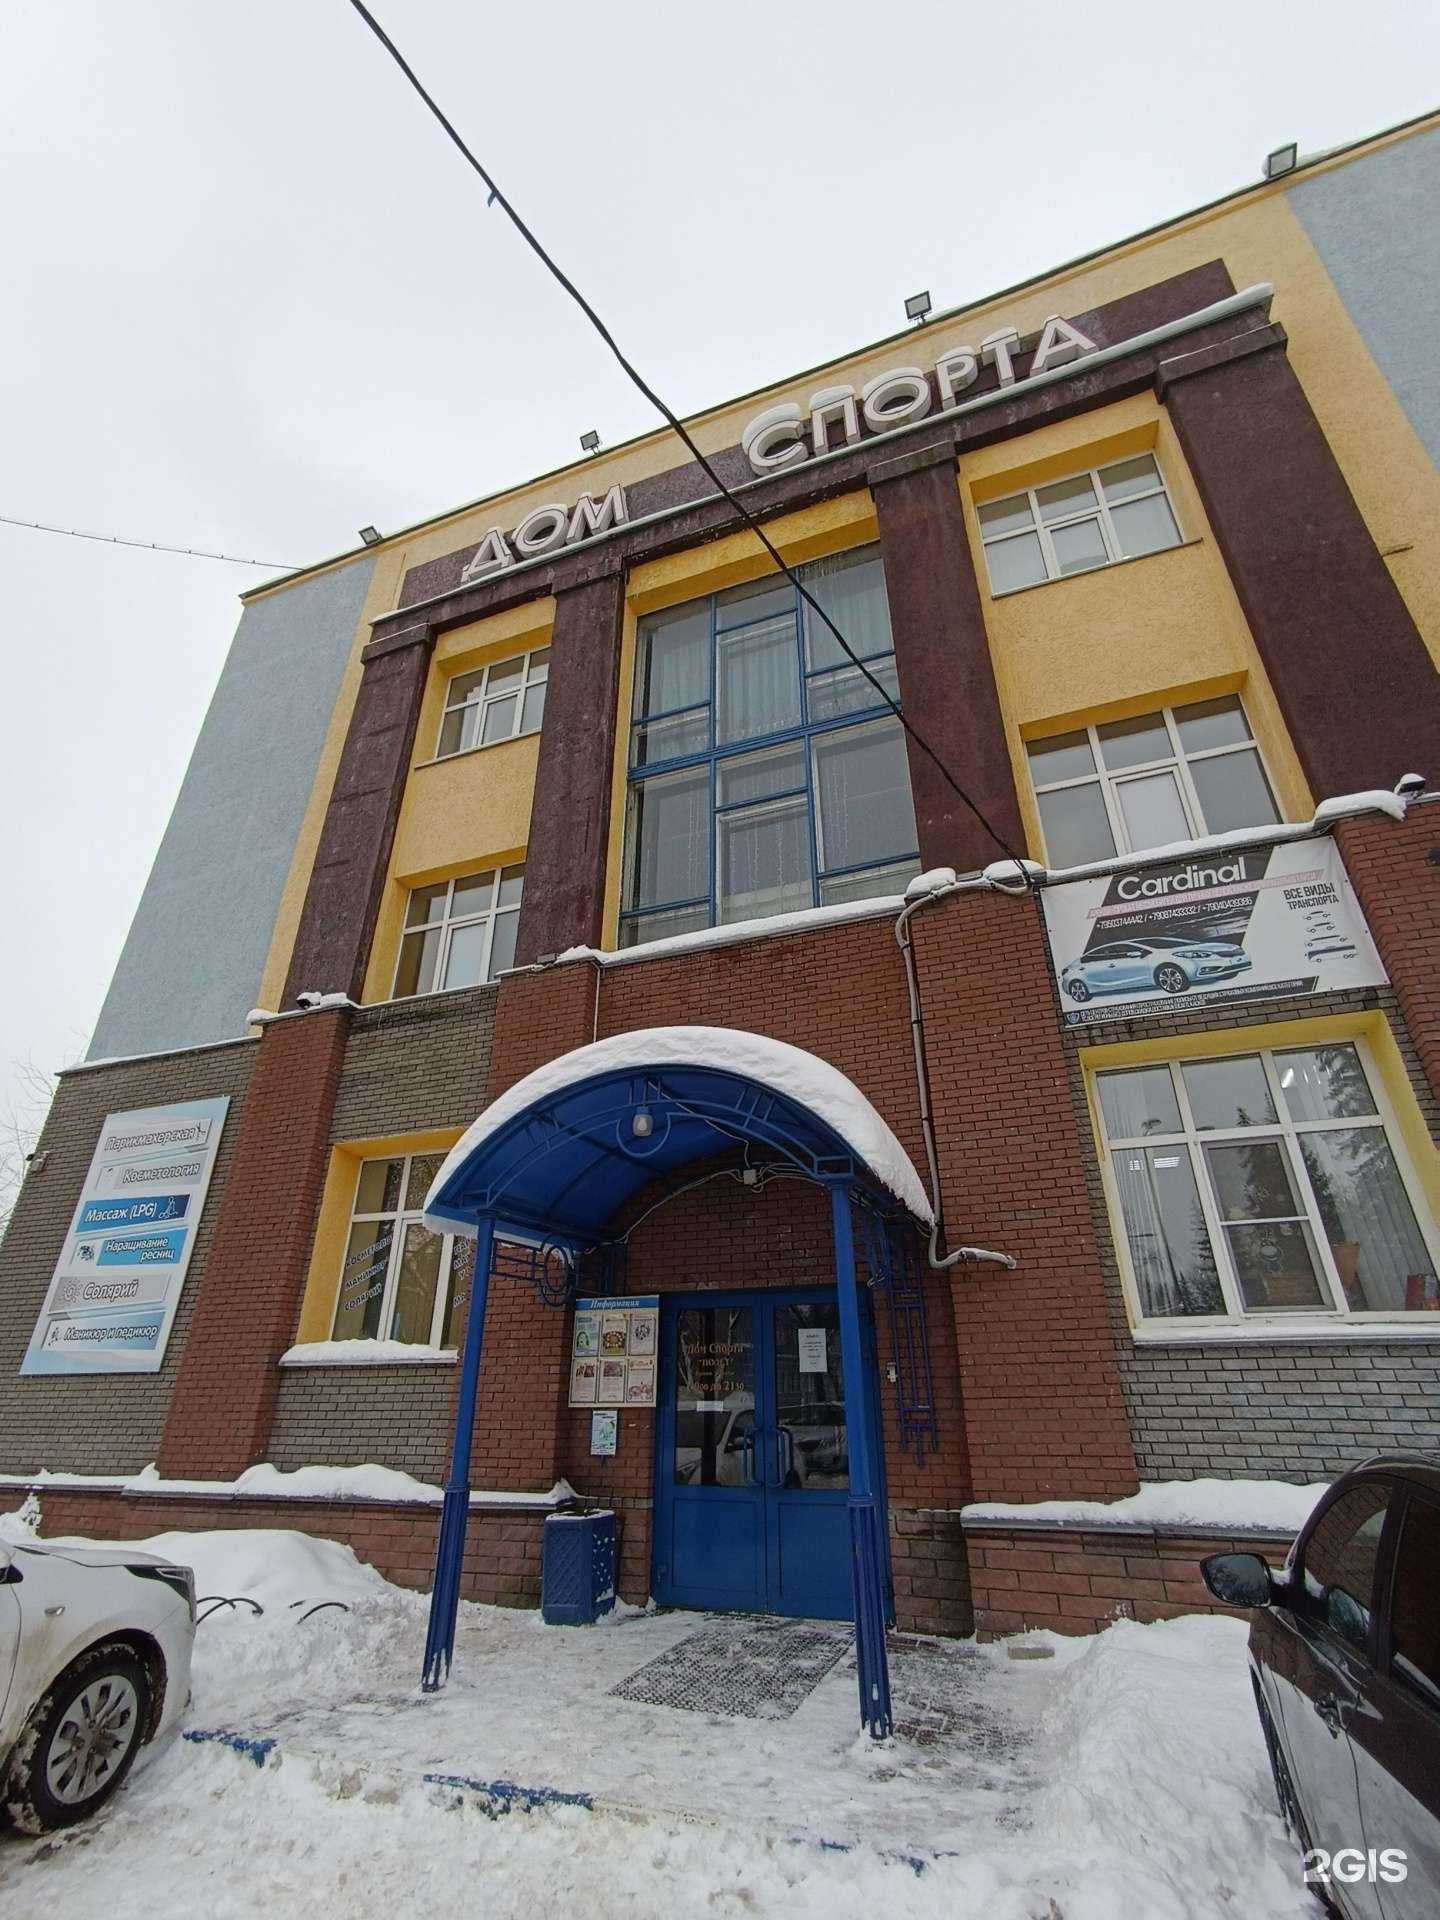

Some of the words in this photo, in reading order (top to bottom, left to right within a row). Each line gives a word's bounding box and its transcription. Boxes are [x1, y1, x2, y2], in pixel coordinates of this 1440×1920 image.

[461, 484, 630, 583] ДОМ
[742, 314, 1096, 477] СПОРТА
[1117, 856, 1247, 900] Cardinal
[1283, 887, 1303, 900] ВСЕ
[1303, 882, 1335, 897] ВИДЫ
[1287, 894, 1340, 910] ТРАНСПОРТА
[104, 1127, 197, 1152] Парикмахерская
[122, 1163, 200, 1184] Косметология
[85, 1208, 128, 1222] Массаж
[129, 1202, 158, 1219] (LPG)
[105, 1238, 168, 1254] Наращивание
[140, 1250, 175, 1263] ресниц
[83, 1279, 139, 1303] Солярий
[63, 1327, 107, 1342] Маникюр
[108, 1330, 115, 1340] и
[115, 1325, 159, 1340] педикюр
